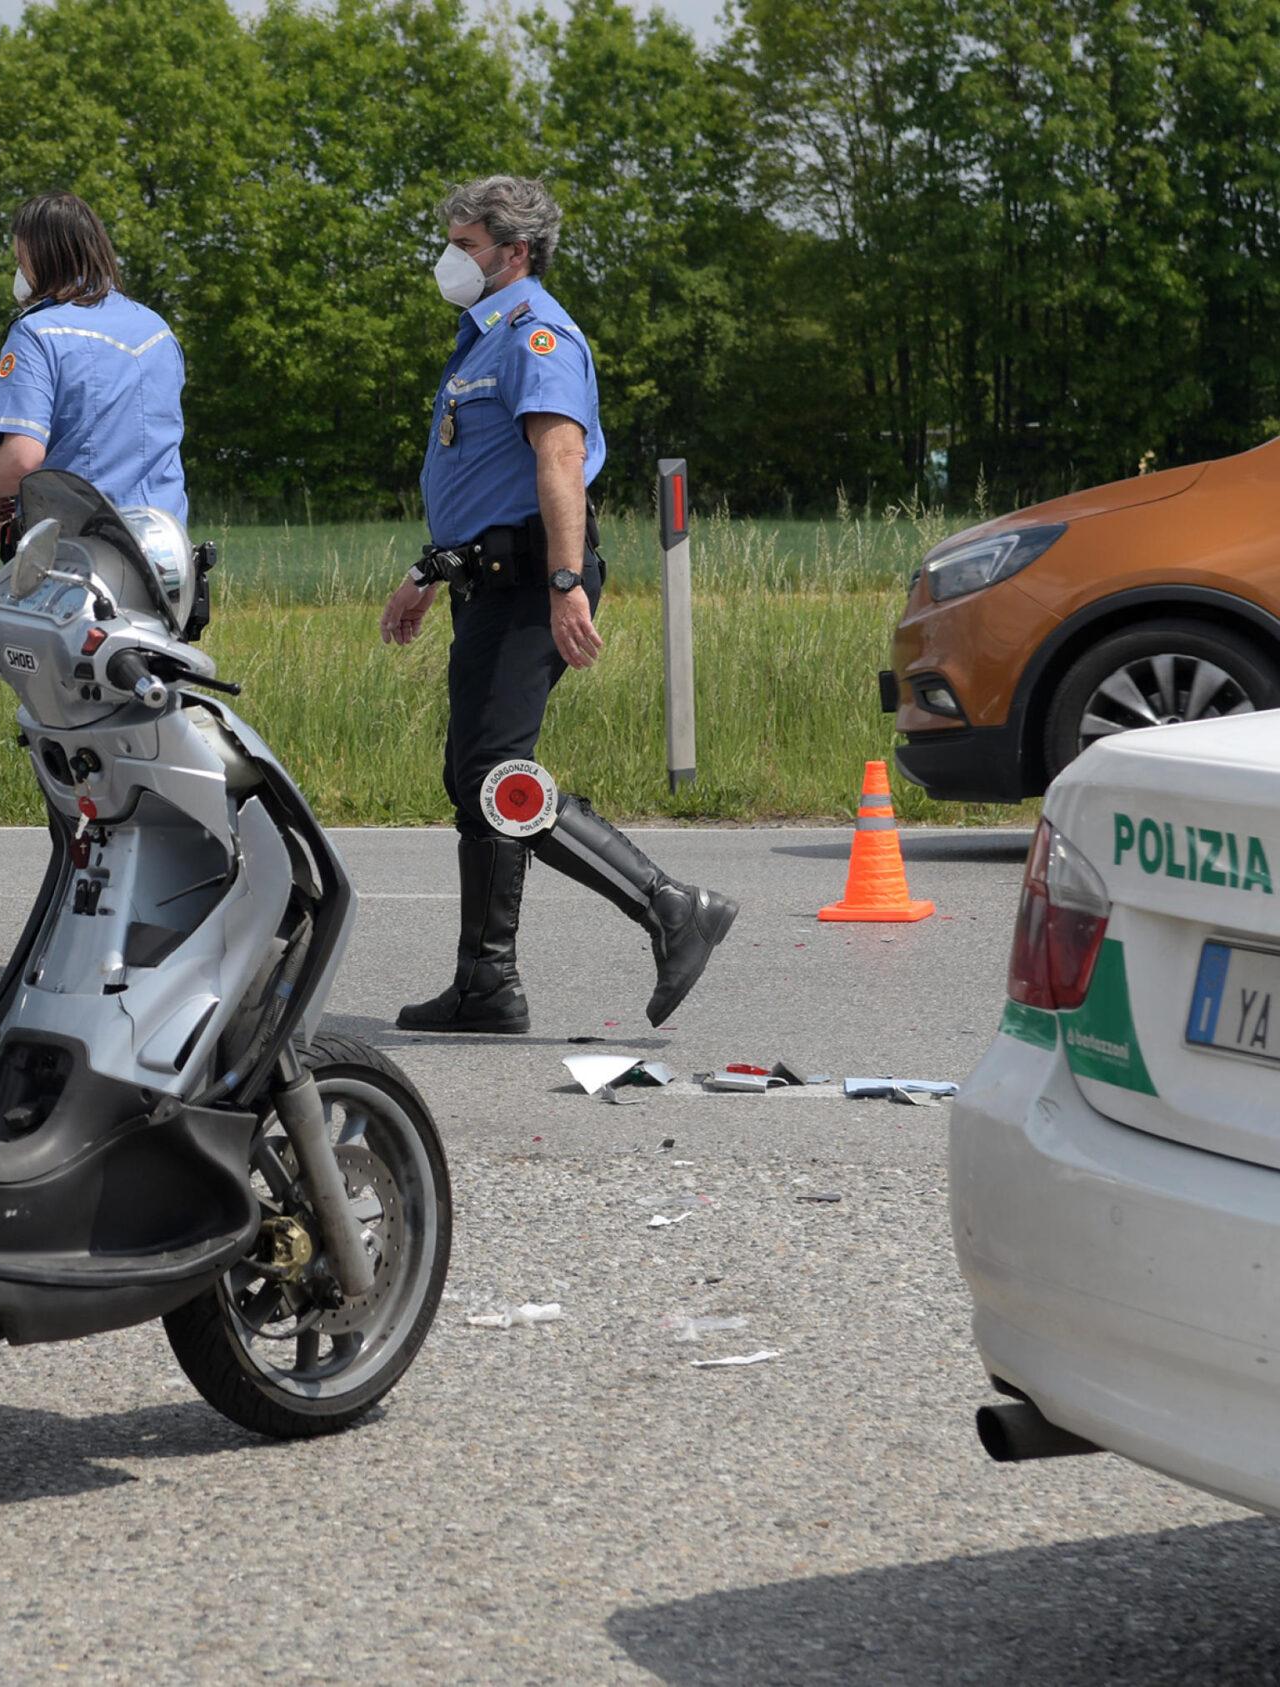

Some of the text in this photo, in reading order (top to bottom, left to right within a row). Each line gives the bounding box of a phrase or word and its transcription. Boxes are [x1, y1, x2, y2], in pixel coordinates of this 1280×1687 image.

[7, 650, 35, 669] SHOEI
[490, 763, 539, 785] GORGONZOLA
[485, 796, 505, 826] COMUNE
[1114, 812, 1273, 894] POLIZIA
[1237, 988, 1270, 1049] YA
